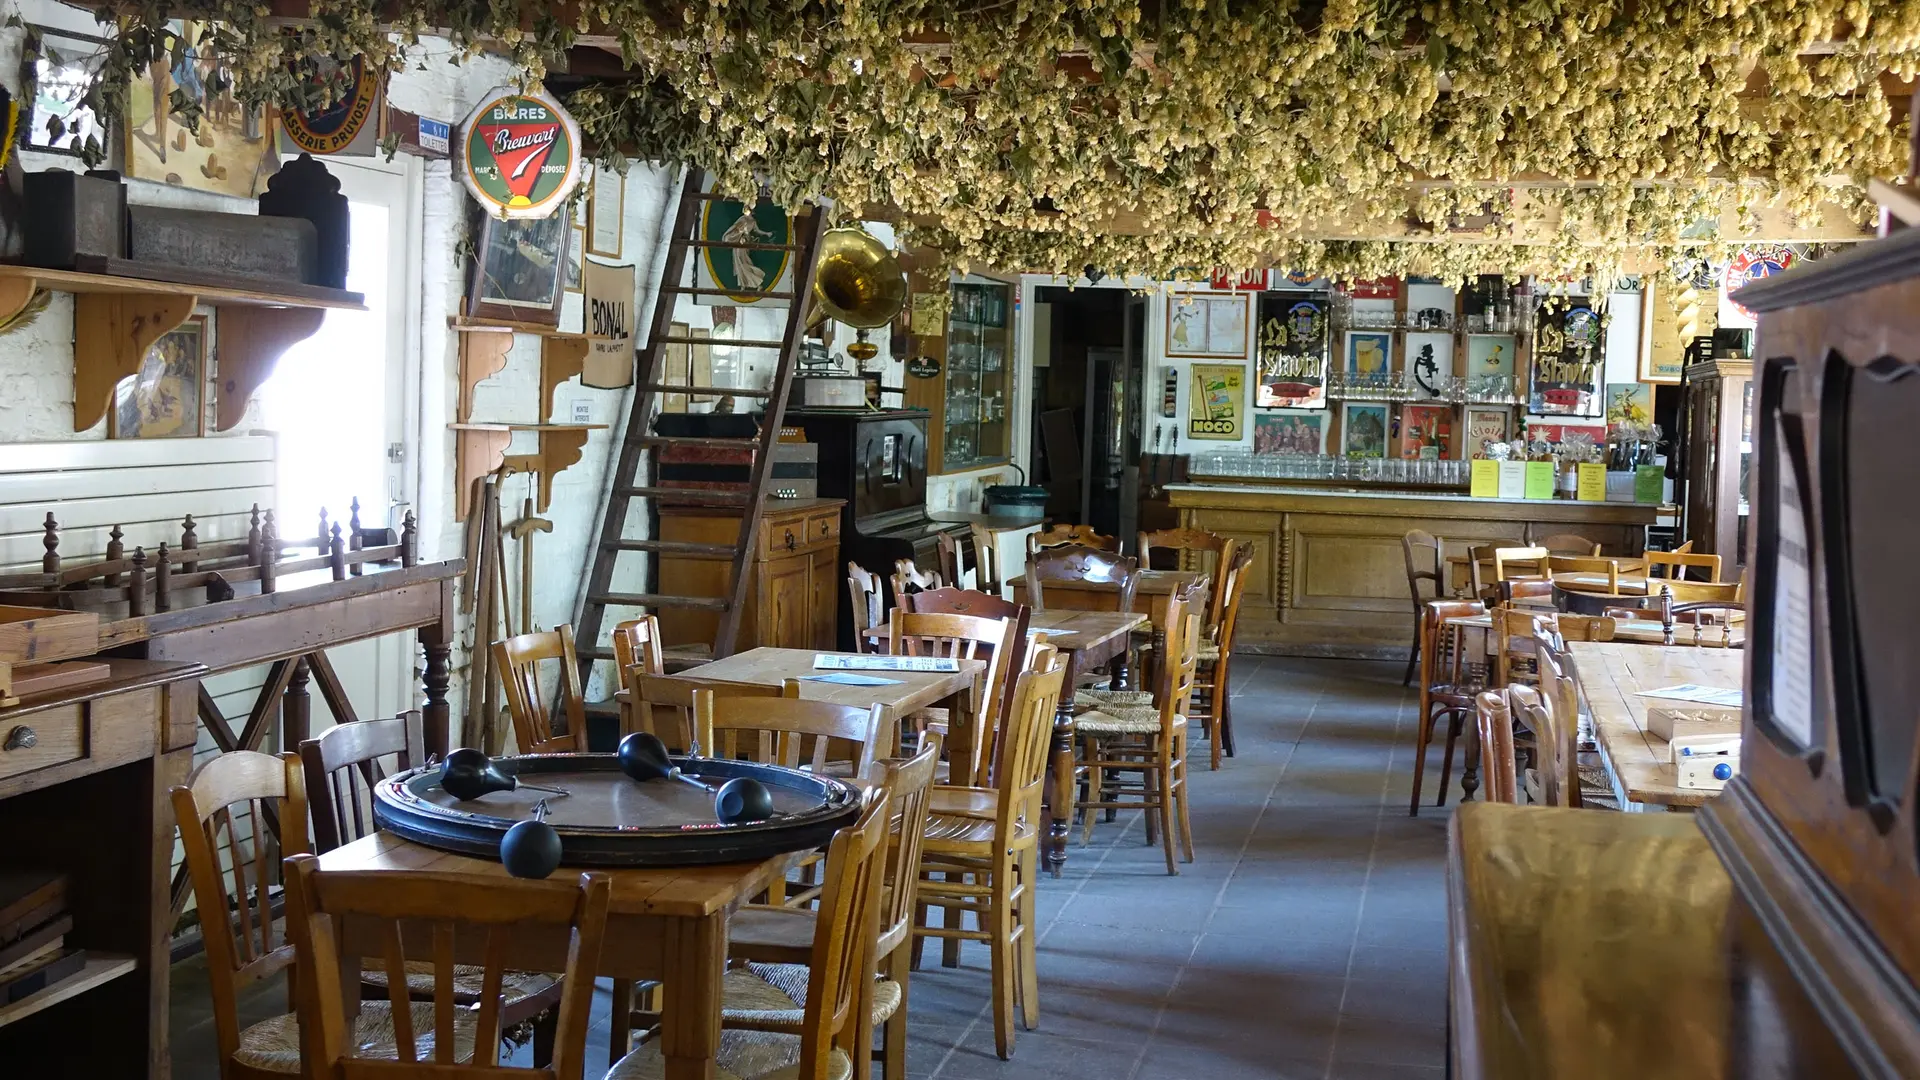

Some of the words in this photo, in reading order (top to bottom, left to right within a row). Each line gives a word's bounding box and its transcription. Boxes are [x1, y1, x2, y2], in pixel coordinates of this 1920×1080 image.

[282, 107, 327, 150] ASSERIE
[332, 94, 370, 148] PRUVOST
[420, 135, 448, 152] TOILETTES
[474, 166, 498, 174] MARE
[541, 165, 566, 174] DÉPOSÉE
[592, 298, 629, 340] BONAL
[1264, 317, 1288, 347] La
[1538, 322, 1564, 353] La
[1264, 348, 1320, 378] Slavia
[1537, 354, 1594, 384] Slavia
[1193, 420, 1234, 433] MOCO
